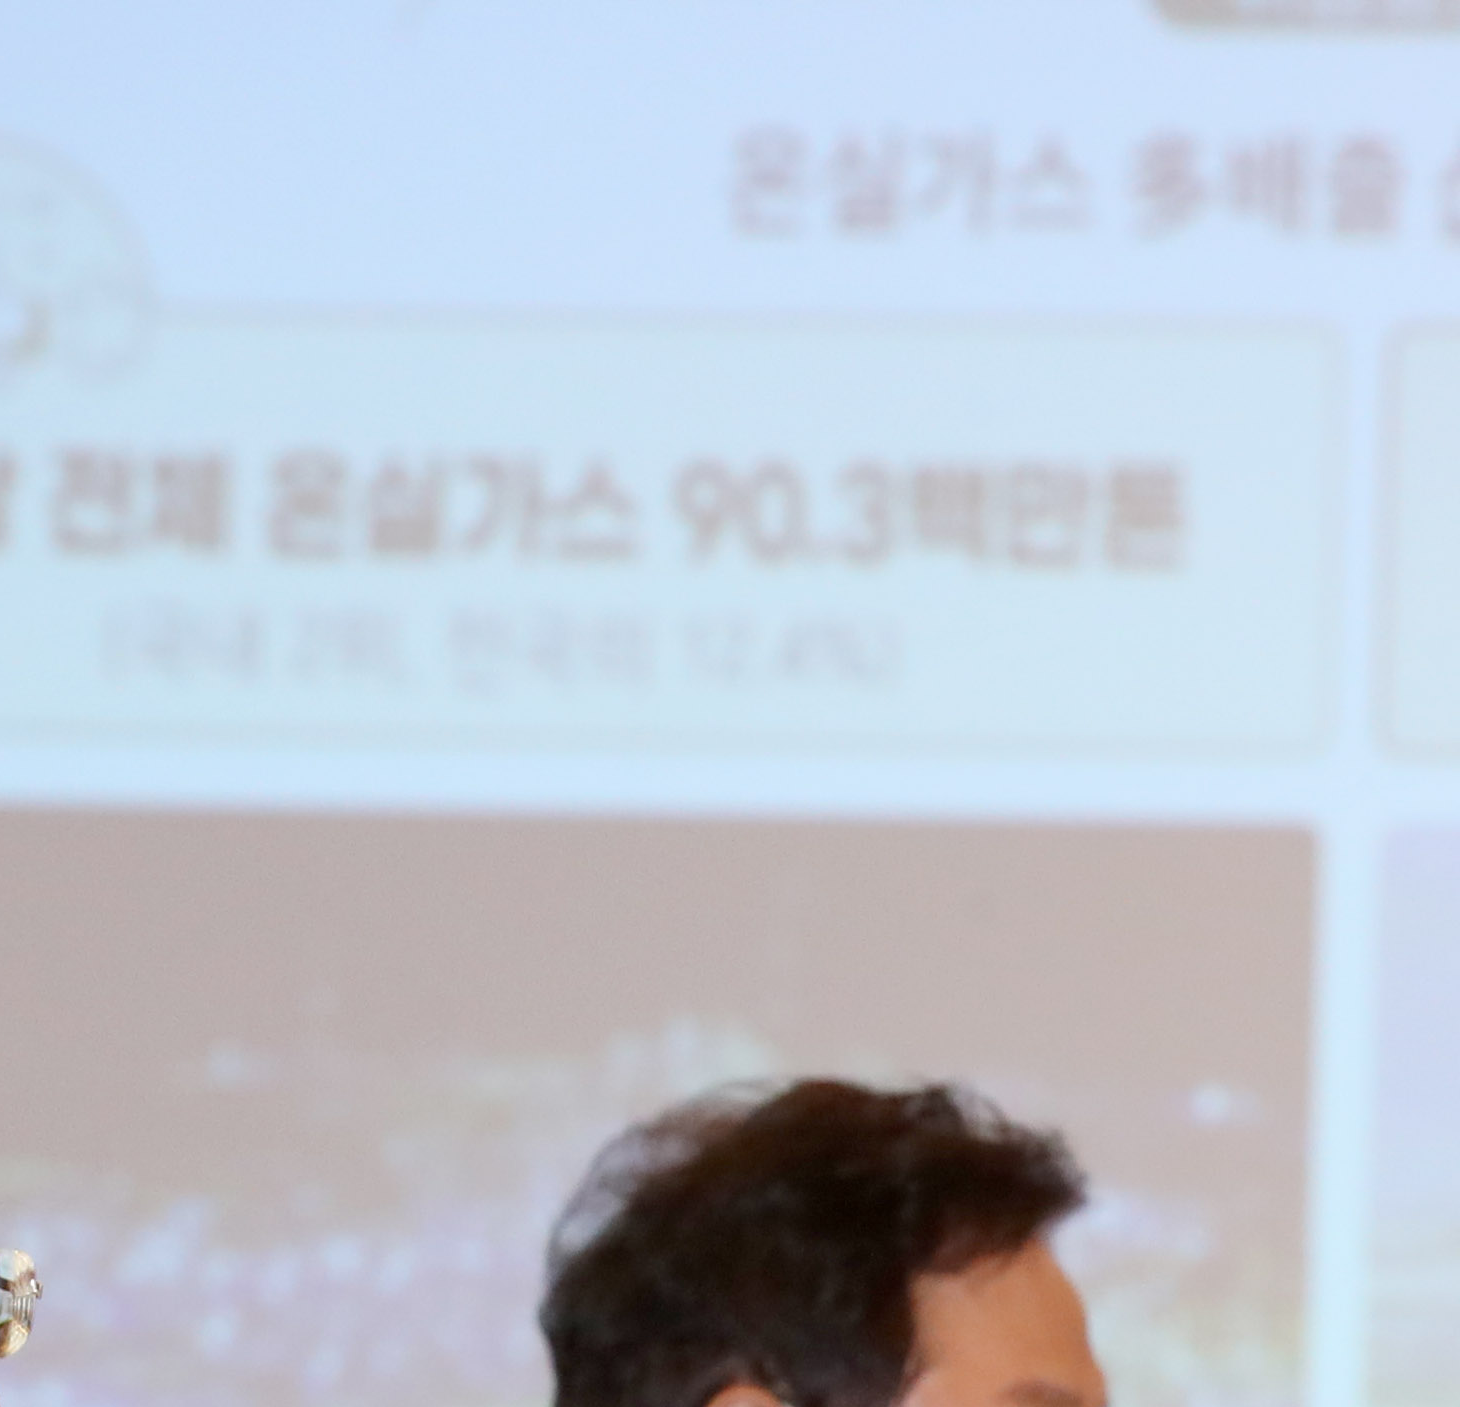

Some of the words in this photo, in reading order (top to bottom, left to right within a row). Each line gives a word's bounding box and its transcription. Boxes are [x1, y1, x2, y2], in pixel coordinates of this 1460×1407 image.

[722, 120, 1095, 236] 온실가스
[48, 446, 230, 558] 전체
[264, 452, 643, 565] 온실가스
